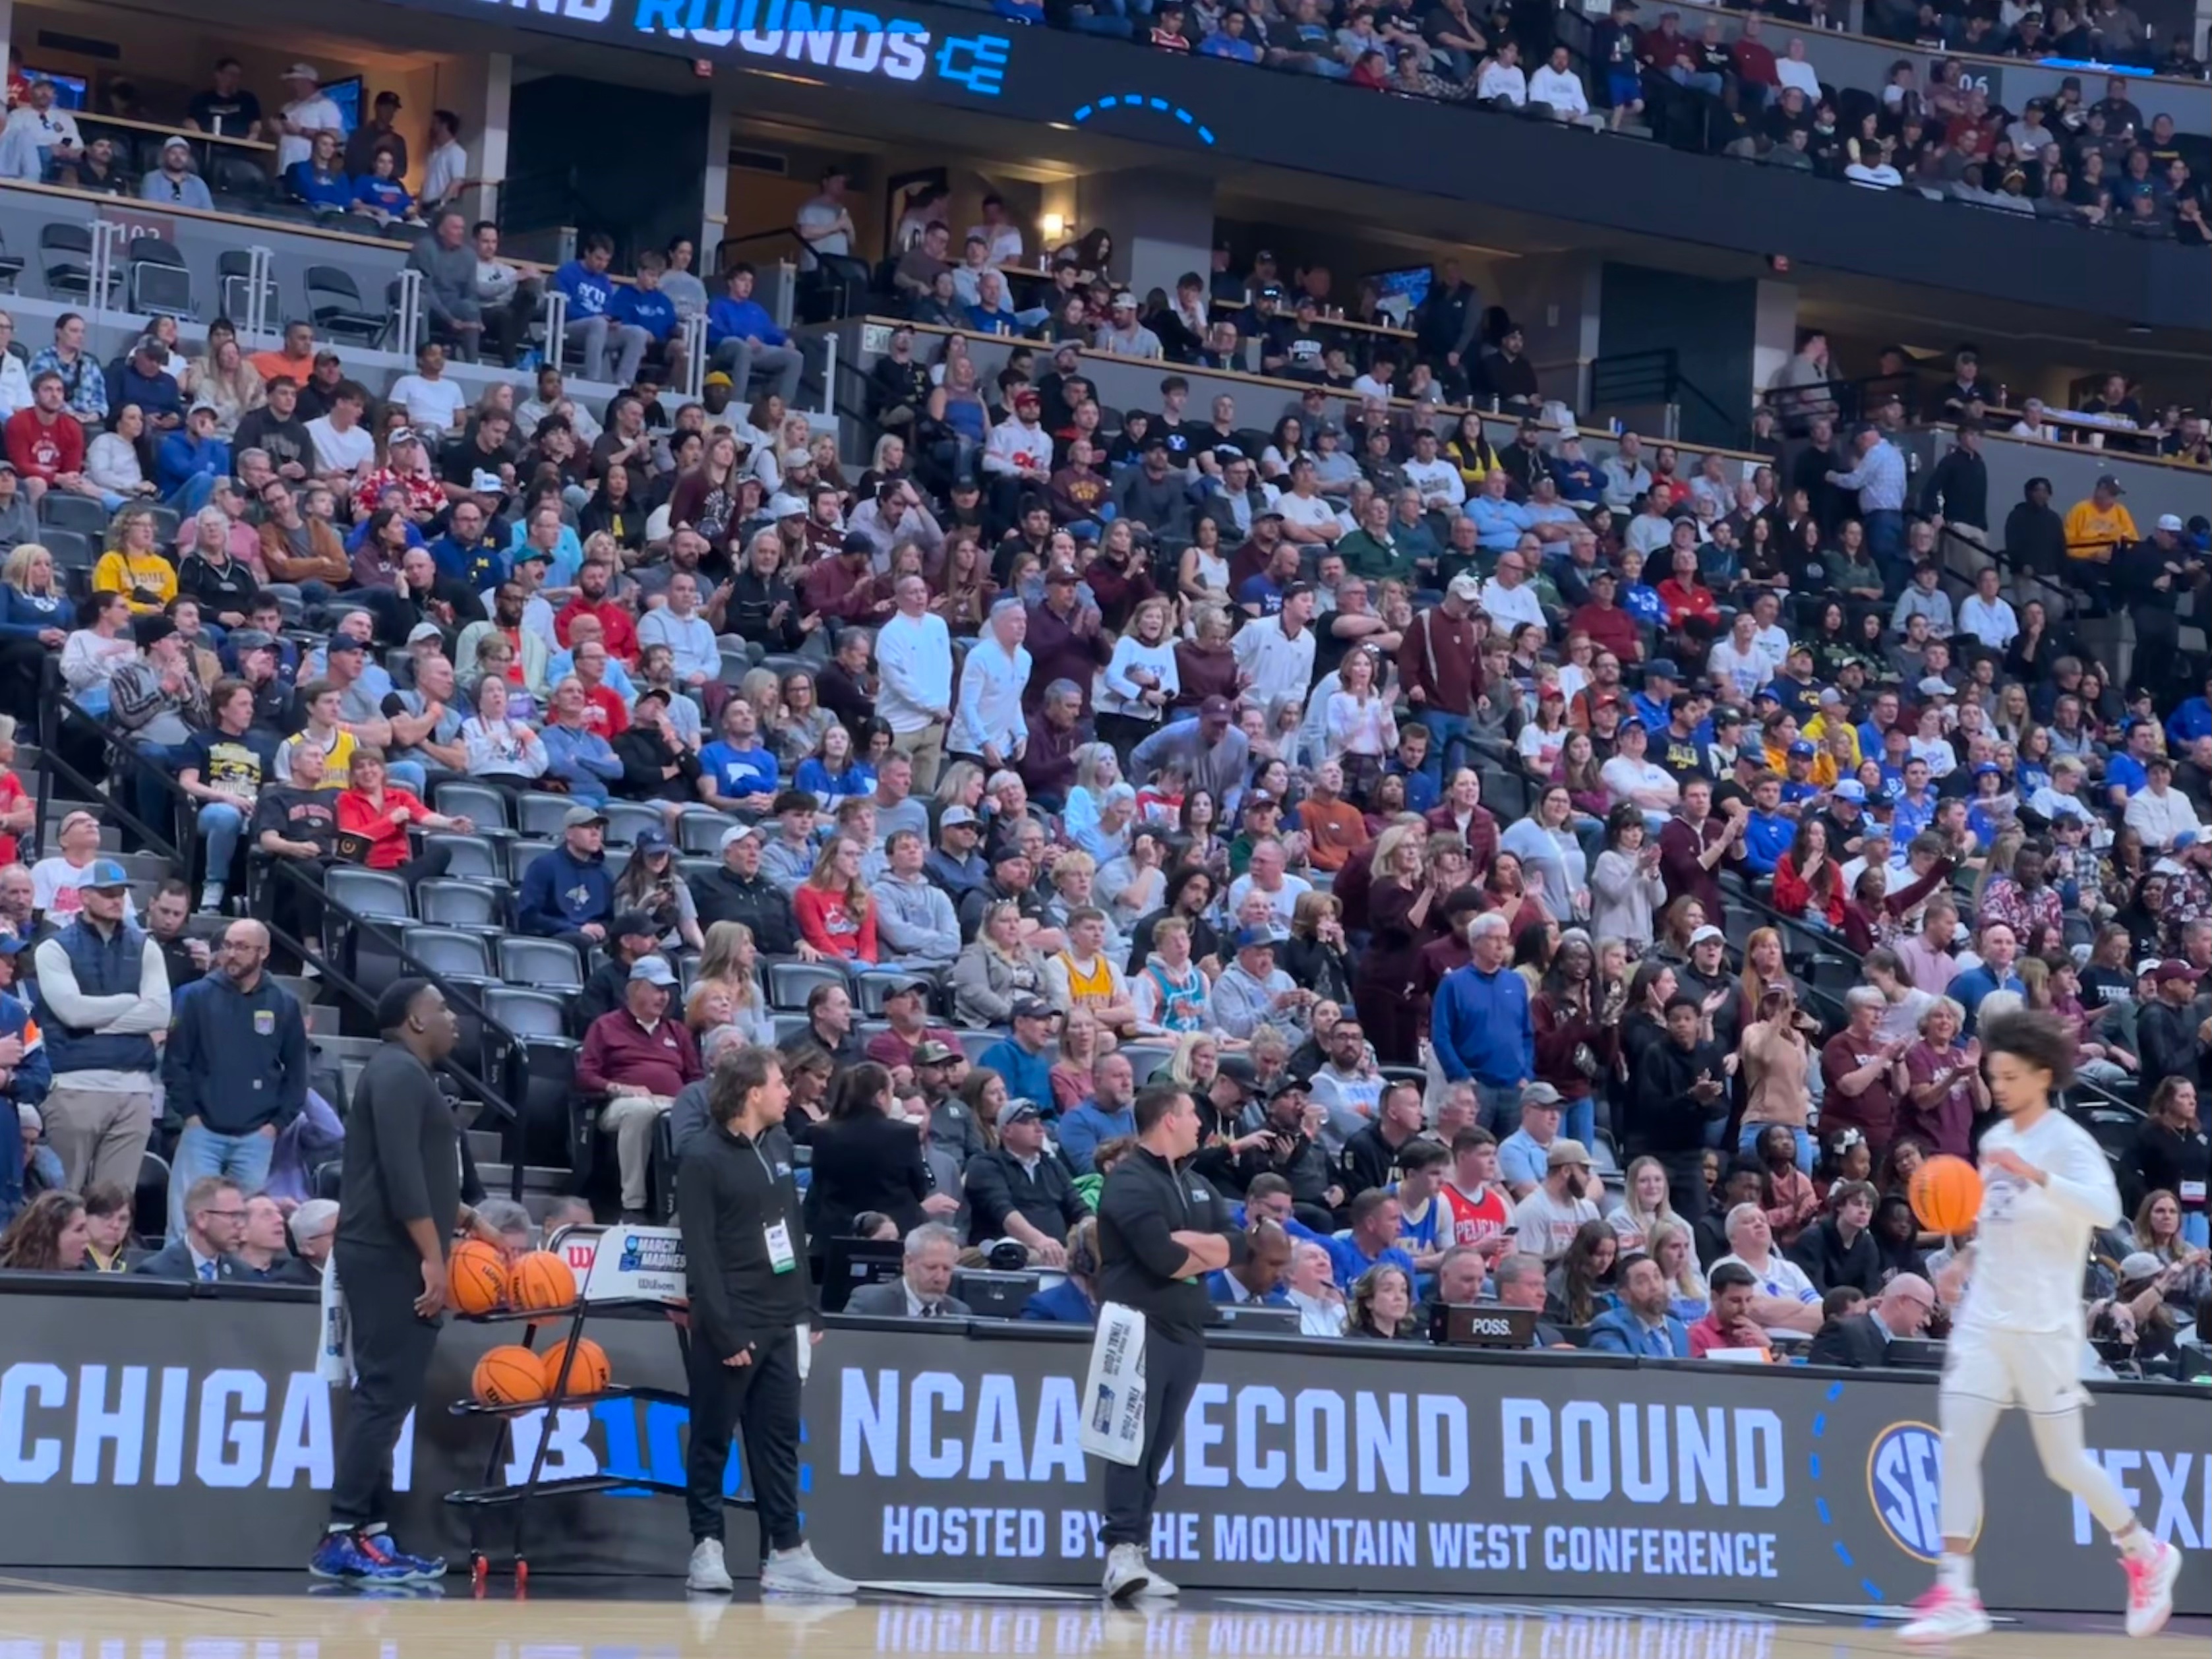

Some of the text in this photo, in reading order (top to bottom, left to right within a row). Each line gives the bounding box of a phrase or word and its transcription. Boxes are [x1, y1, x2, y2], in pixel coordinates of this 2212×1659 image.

[634, 0, 930, 80] ROUNDS
[1959, 74, 1988, 96] 06
[638, 1237, 678, 1253] MARCH
[640, 1253, 687, 1268] MADNES
[638, 1277, 676, 1291] Wilson
[1106, 1321, 1123, 1349] FINAL
[1472, 1318, 1512, 1335] POSS.
[1102, 1349, 1116, 1375] FOUR
[1125, 1385, 1141, 1415] FINAL
[839, 1368, 1086, 1482] NCAA
[1120, 1415, 1133, 1441] FOUR
[1156, 1383, 1470, 1496] ECOND
[1501, 1397, 1785, 1507] ROUND
[1876, 1432, 1942, 1553] SE
[2072, 1448, 2212, 1550] TEX
[882, 1505, 1778, 1578] HOSTED BY HE MOUNTAIN WEST CONFERENCE
